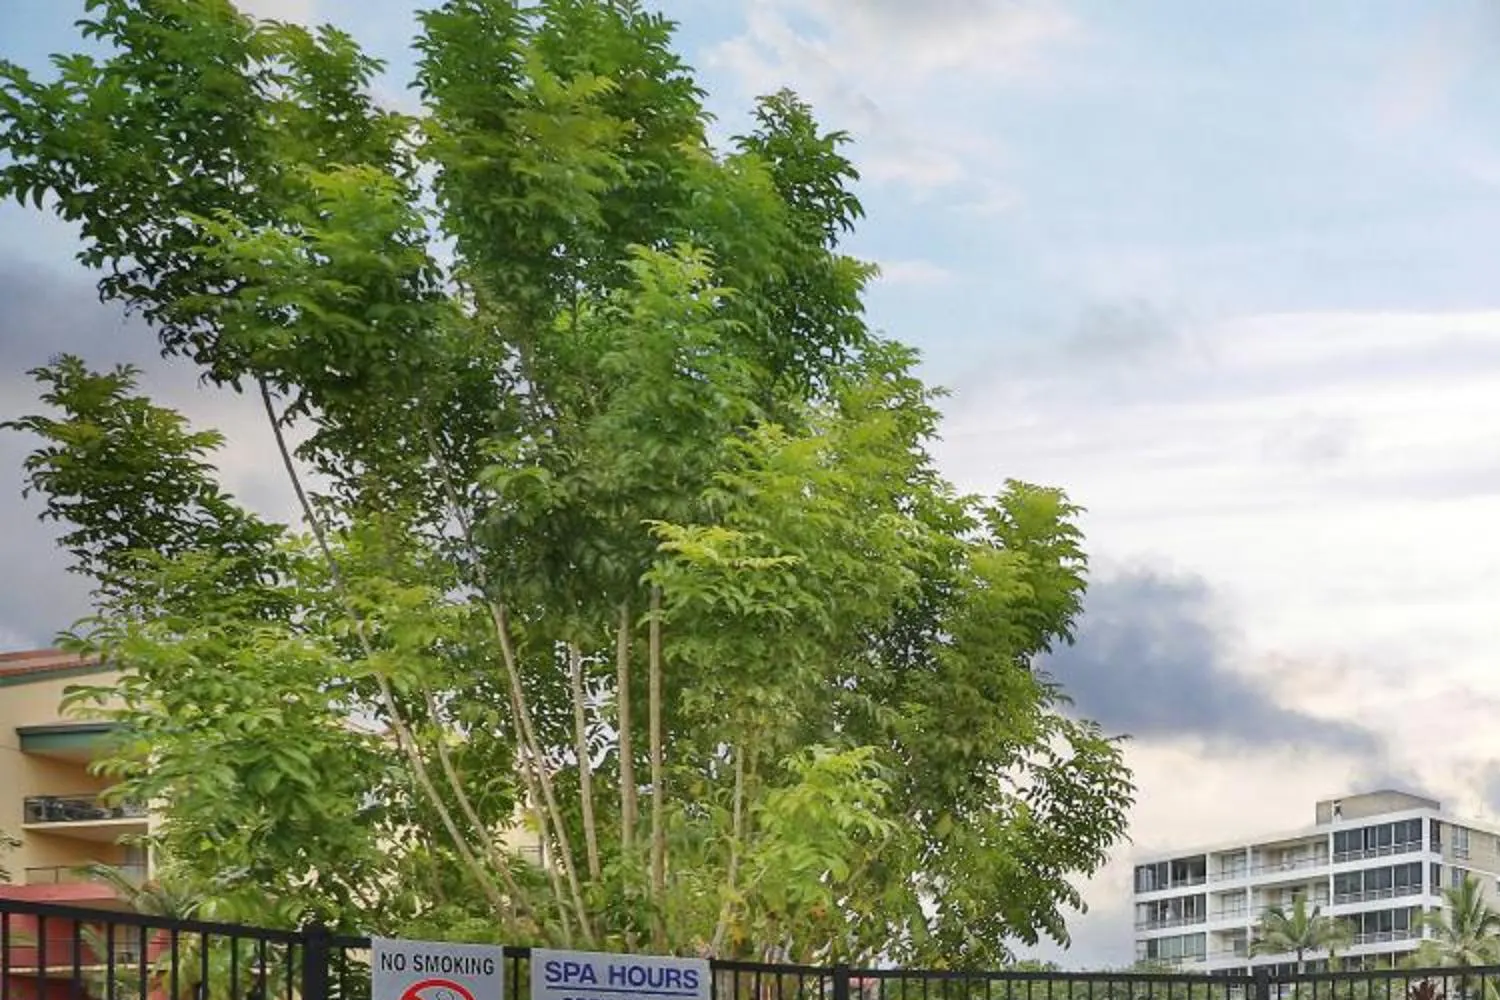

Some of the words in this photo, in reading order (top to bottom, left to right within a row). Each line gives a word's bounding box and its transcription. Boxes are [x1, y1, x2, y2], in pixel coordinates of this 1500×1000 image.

[381, 952, 406, 971] NO
[413, 954, 495, 976] SMOKING
[544, 960, 597, 984] SPA
[608, 965, 699, 989] HOURS
